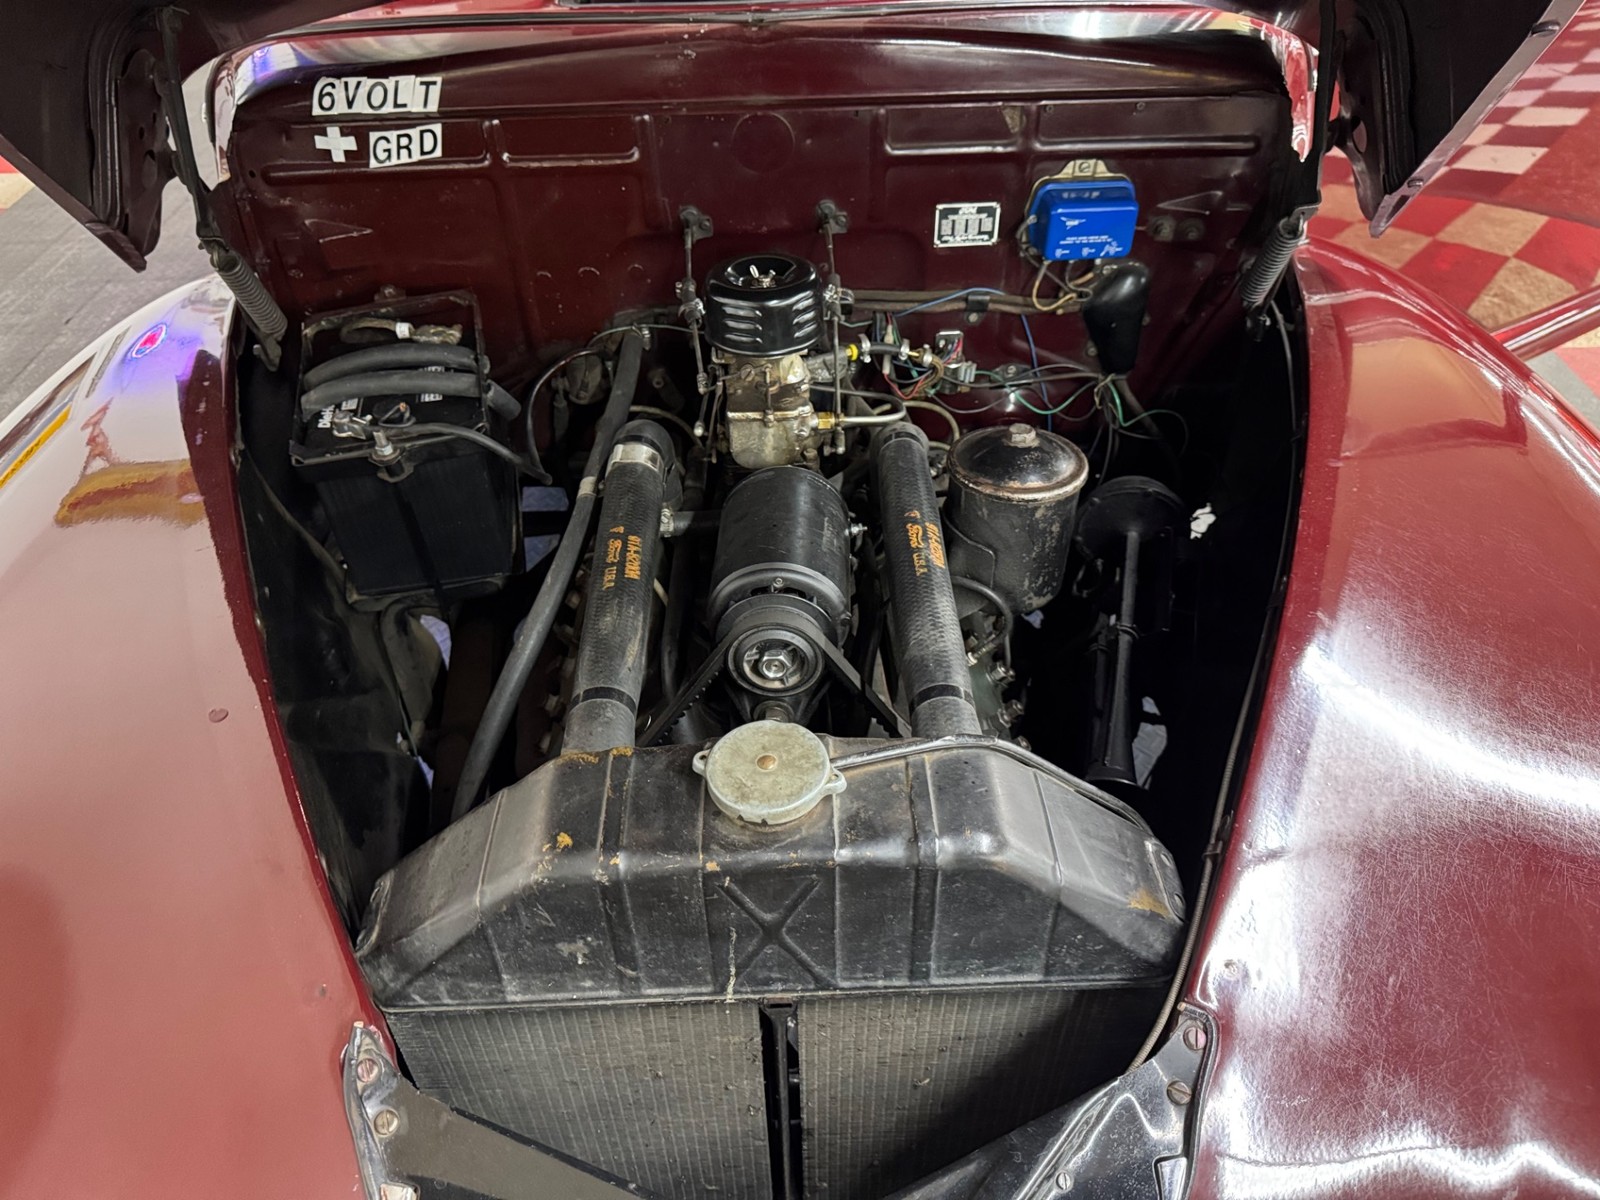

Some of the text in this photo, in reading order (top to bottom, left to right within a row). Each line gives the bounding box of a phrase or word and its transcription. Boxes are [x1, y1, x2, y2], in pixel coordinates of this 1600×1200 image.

[317, 80, 438, 112] 6VOLT
[372, 128, 438, 164] GRD
[906, 523, 924, 549] Ford
[606, 538, 622, 564] Ford
